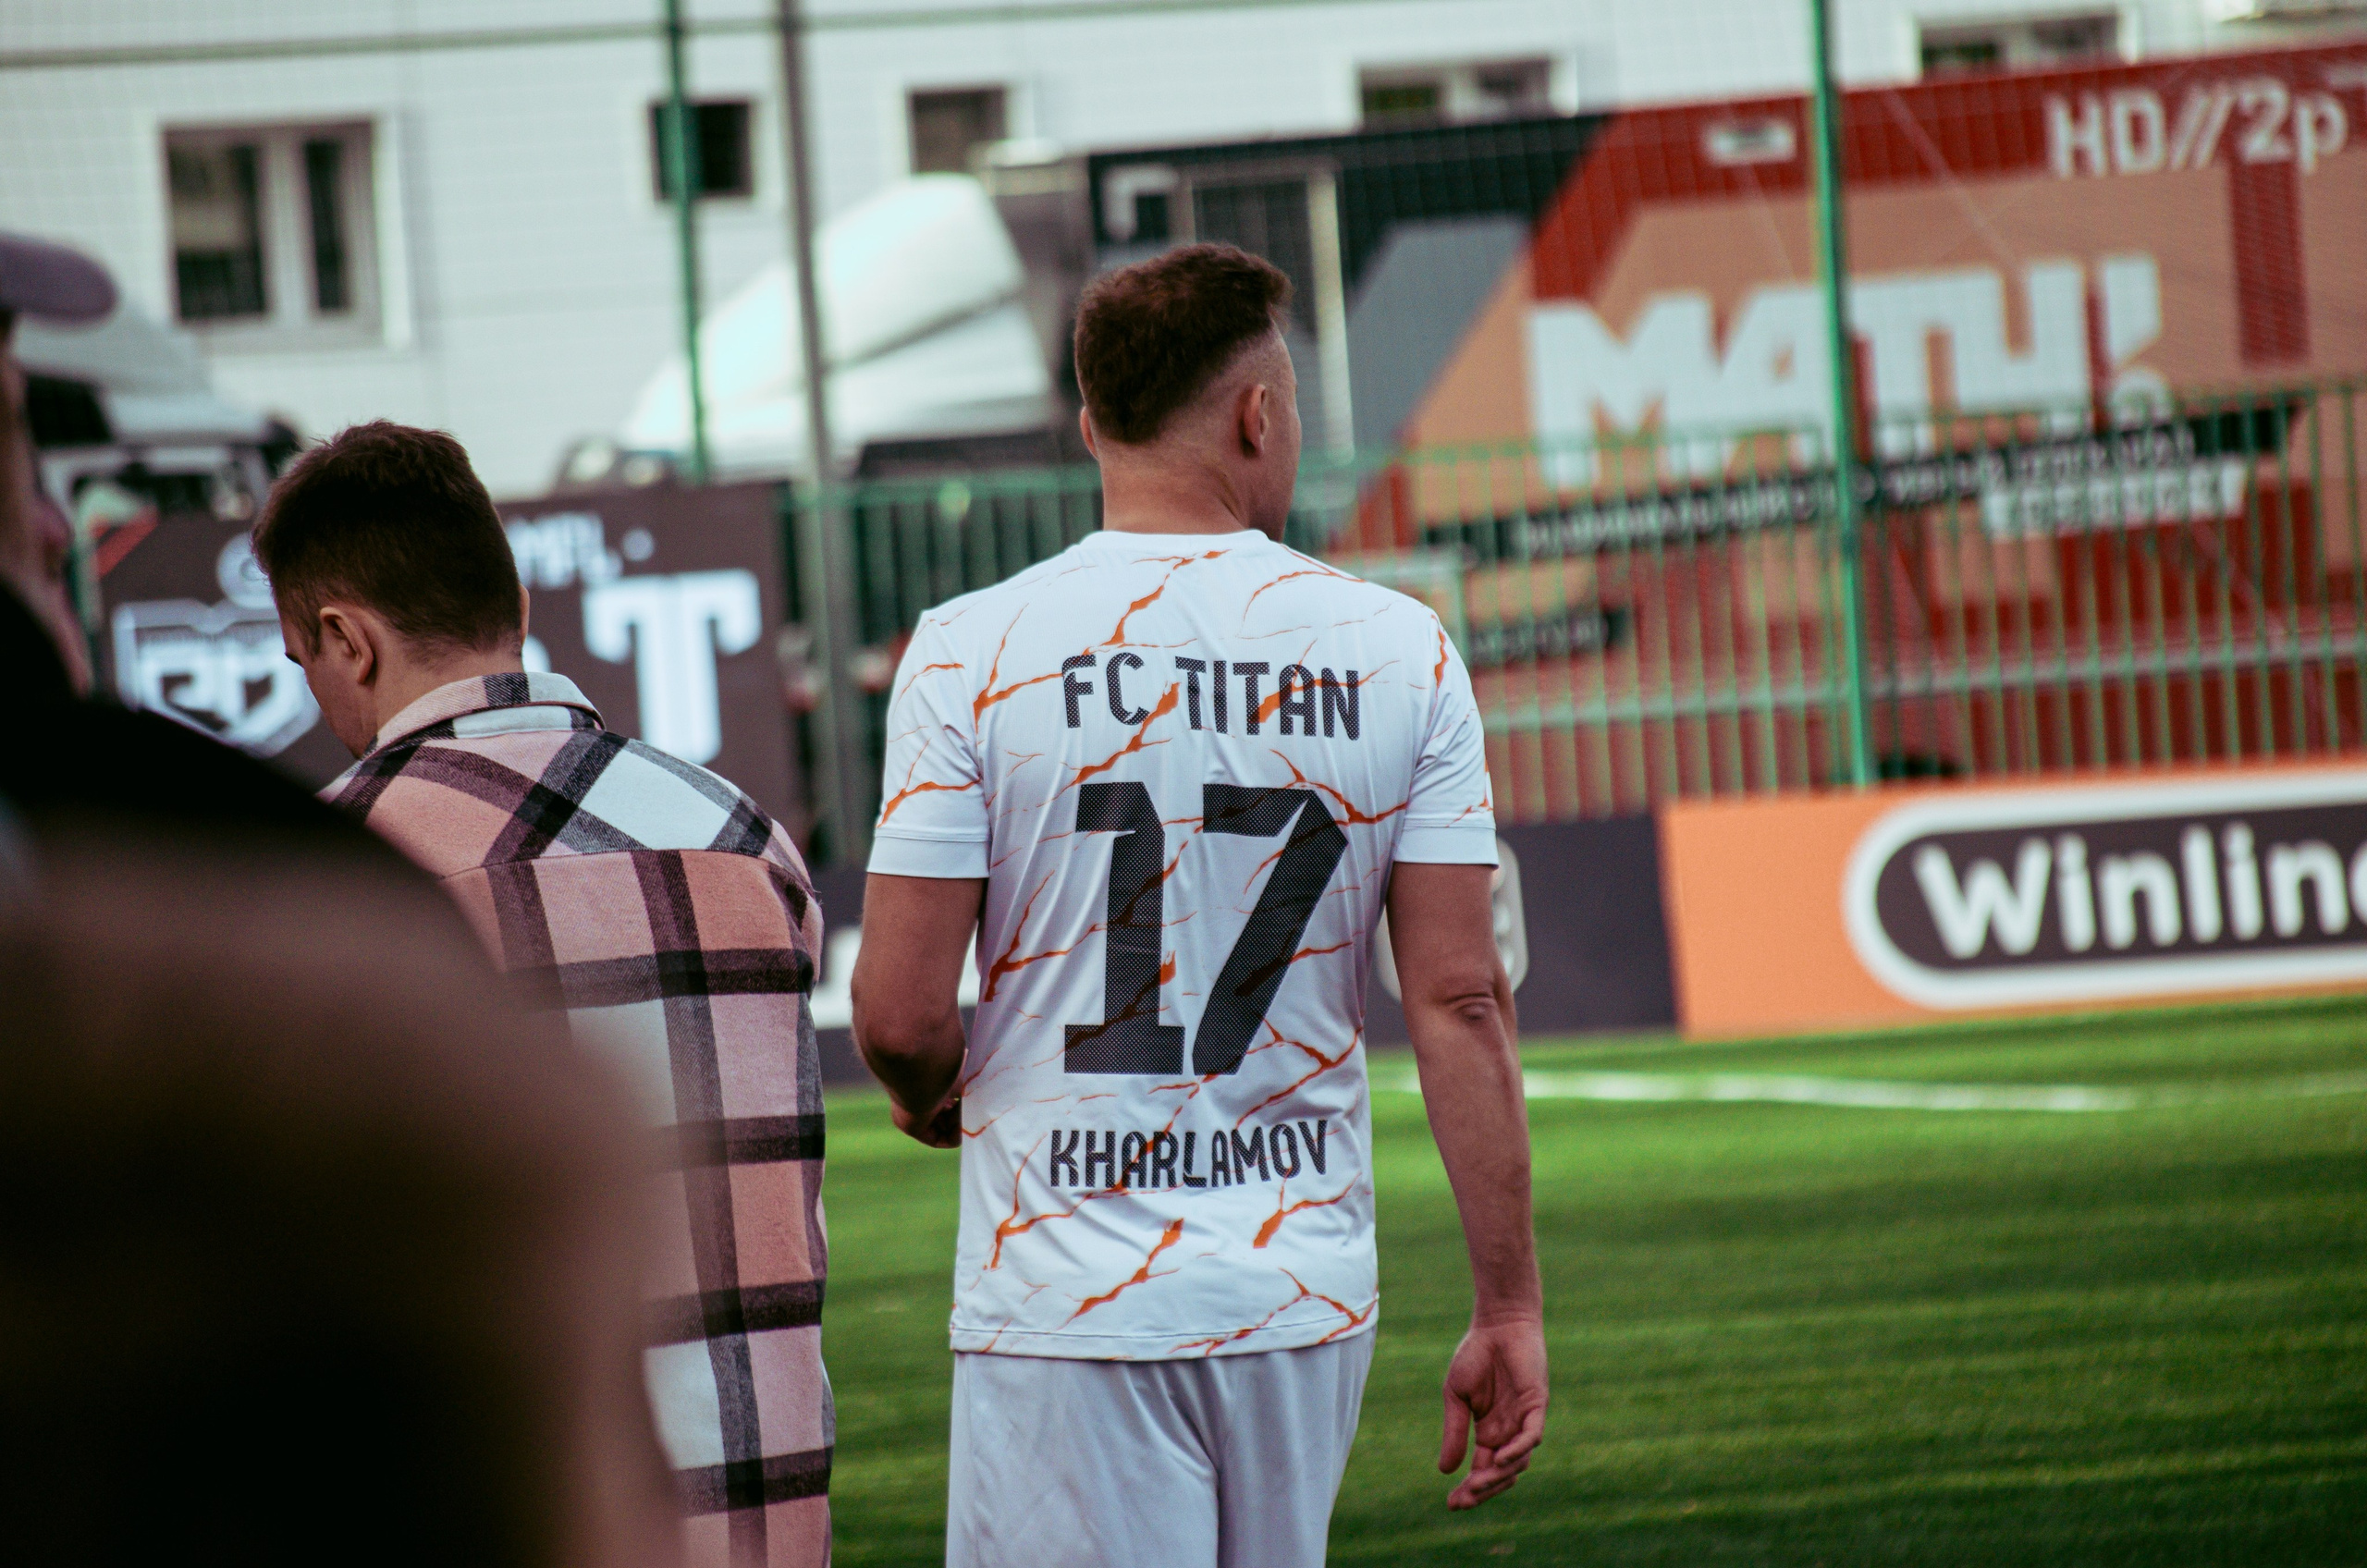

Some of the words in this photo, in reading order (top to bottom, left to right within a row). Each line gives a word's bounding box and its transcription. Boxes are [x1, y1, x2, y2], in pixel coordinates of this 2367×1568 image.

[1062, 653, 1149, 728] FC
[1175, 655, 1360, 741] TITAN
[1063, 781, 1349, 1075] 17
[1912, 815, 2367, 960] Winlin
[1050, 1119, 1329, 1188] KHARLAMOV
